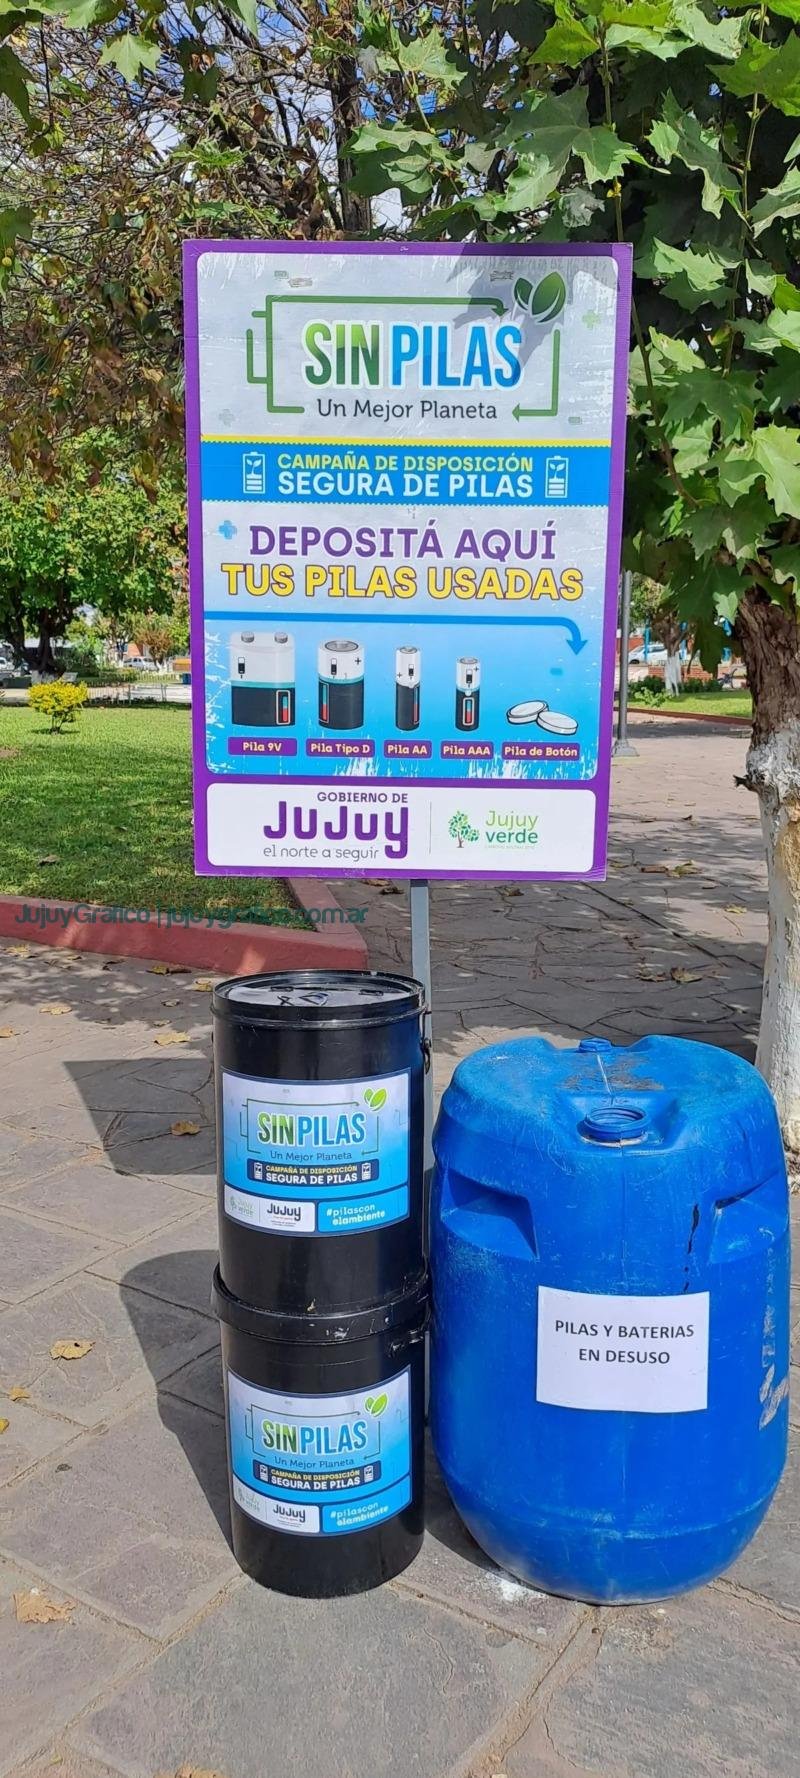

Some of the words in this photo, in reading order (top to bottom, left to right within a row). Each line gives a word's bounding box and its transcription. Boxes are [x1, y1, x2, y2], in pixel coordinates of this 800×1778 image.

[304, 322, 380, 386] SIN
[391, 324, 522, 388] PILAS
[317, 399, 347, 417] Un
[354, 400, 413, 423] Mejor
[420, 401, 497, 420] Planeta
[278, 451, 369, 471] CAMPAÑA
[374, 455, 399, 471] DE
[404, 452, 533, 472] DISPOSICIÓN
[278, 471, 394, 496] SEGURA
[403, 474, 438, 497] DE
[449, 474, 533, 498] PILAS
[249, 520, 442, 558] DEPOSITÁ
[454, 520, 556, 562] AQUÍ
[221, 563, 295, 597] TUS
[305, 564, 417, 599] PILAS
[427, 567, 584, 601] USADAS
[242, 741, 265, 752] Pila
[267, 742, 282, 752] 9V
[310, 743, 329, 754] Pila
[332, 743, 360, 756] Tipo
[362, 744, 370, 754] D
[387, 744, 406, 755] Pila
[408, 745, 427, 755] AA
[443, 745, 461, 755] Pila
[463, 746, 490, 756] AAA
[504, 746, 523, 757] Pila
[525, 746, 541, 757] de
[545, 746, 578, 757] Botón
[317, 791, 388, 803] GOBIERNO
[391, 793, 408, 803] DE
[486, 810, 539, 831] Jujuy
[485, 829, 538, 844] verde
[263, 845, 277, 857] el
[280, 846, 318, 858] norte
[322, 848, 332, 858] a
[334, 846, 379, 862] seguir
[270, 1151, 283, 1160] Un
[286, 1152, 313, 1163] Mejor
[317, 1152, 352, 1161] Planeta
[266, 1173, 307, 1184] SEGURA
[310, 1175, 324, 1184] DE
[327, 1173, 357, 1184] PILAS
[327, 1204, 375, 1218] #pilascon
[555, 1320, 598, 1336] PILAS
[604, 1325, 613, 1337] Y
[618, 1324, 694, 1338] BATERIAS
[579, 1348, 600, 1362] EN
[605, 1350, 670, 1364] DESUSO
[274, 1456, 288, 1466] Un
[290, 1458, 316, 1469] Mejor
[319, 1458, 355, 1468] Planeta
[271, 1477, 310, 1490] SEGURA
[314, 1482, 327, 1490] DE
[330, 1477, 361, 1489] PILAS
